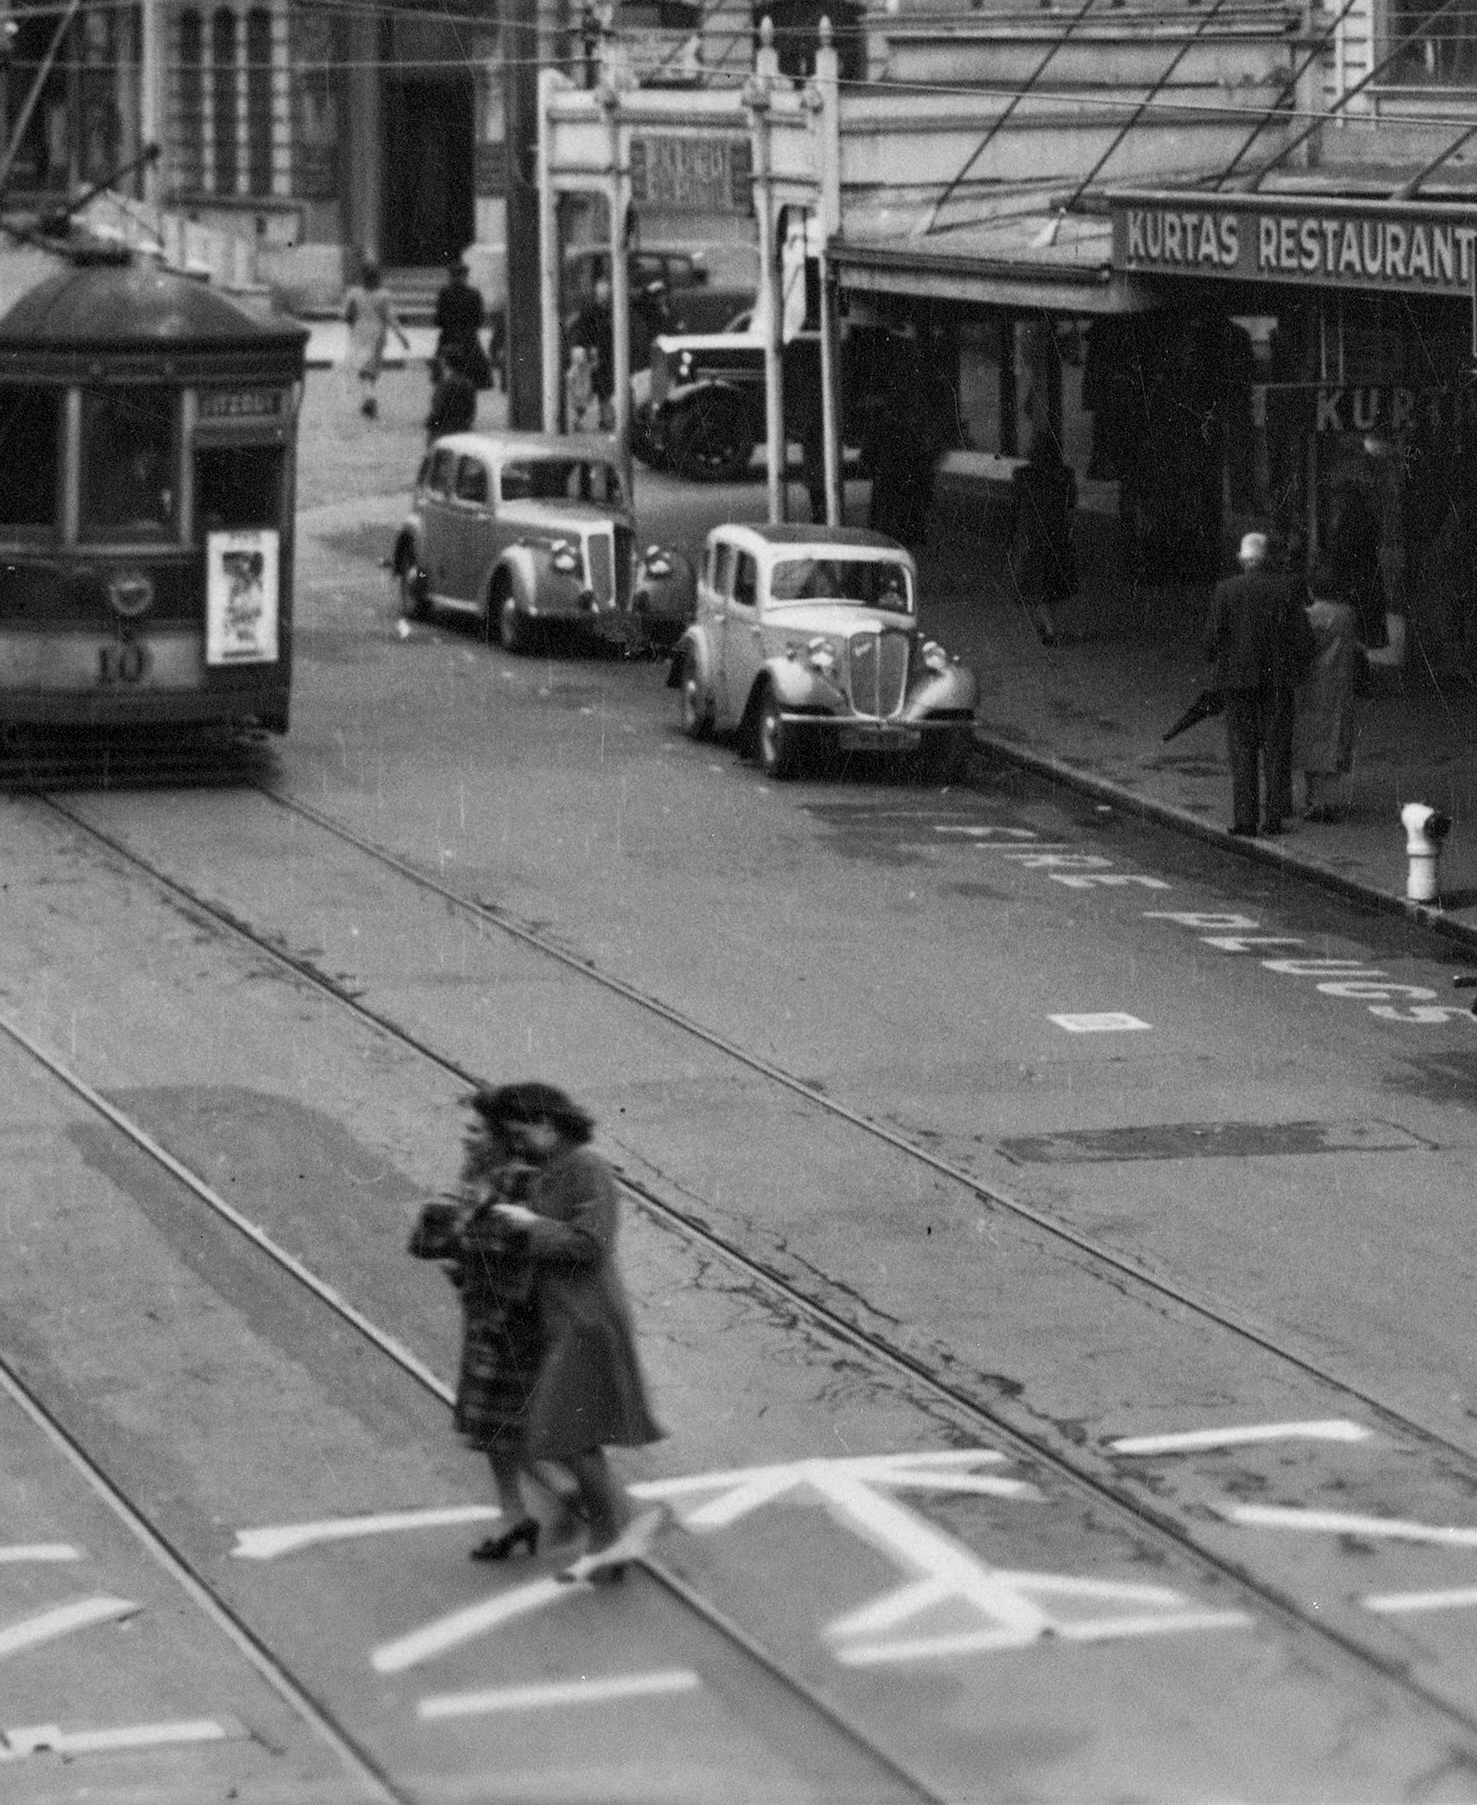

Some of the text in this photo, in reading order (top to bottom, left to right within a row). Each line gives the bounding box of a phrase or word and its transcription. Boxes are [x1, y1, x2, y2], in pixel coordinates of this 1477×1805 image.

[1125, 210, 1475, 285] KURTAS RESTAURANT
[933, 825, 1173, 890] FIRE
